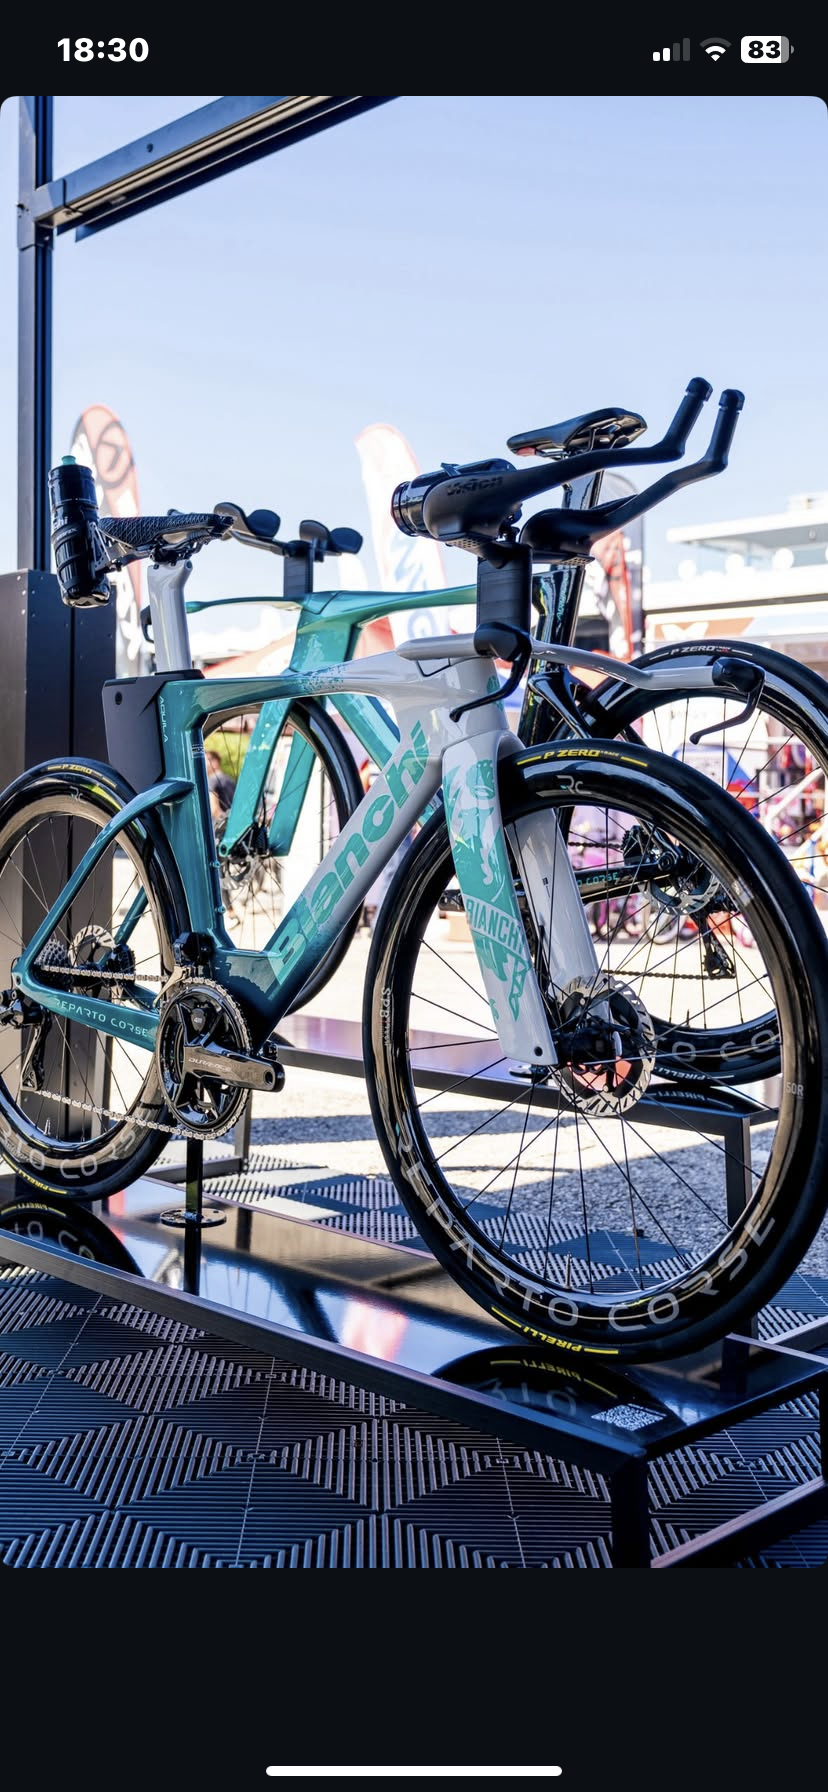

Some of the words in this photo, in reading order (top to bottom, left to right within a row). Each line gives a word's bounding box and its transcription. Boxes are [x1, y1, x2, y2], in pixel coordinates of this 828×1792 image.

[681, 645, 715, 653] ZERO
[159, 695, 169, 743] AQUILA
[543, 751, 555, 760] P
[557, 749, 601, 757] ZERO
[70, 764, 92, 774] ZERO
[267, 720, 430, 985] Bianchi
[586, 871, 619, 886] CORSE
[56, 999, 106, 1022] REPARTO
[111, 1018, 148, 1037] CORSE
[658, 1066, 706, 1081] PIRELLI
[395, 1110, 579, 1327] REPARTO
[608, 1203, 776, 1333] CORSE
[522, 1326, 583, 1352] PIRELLI
